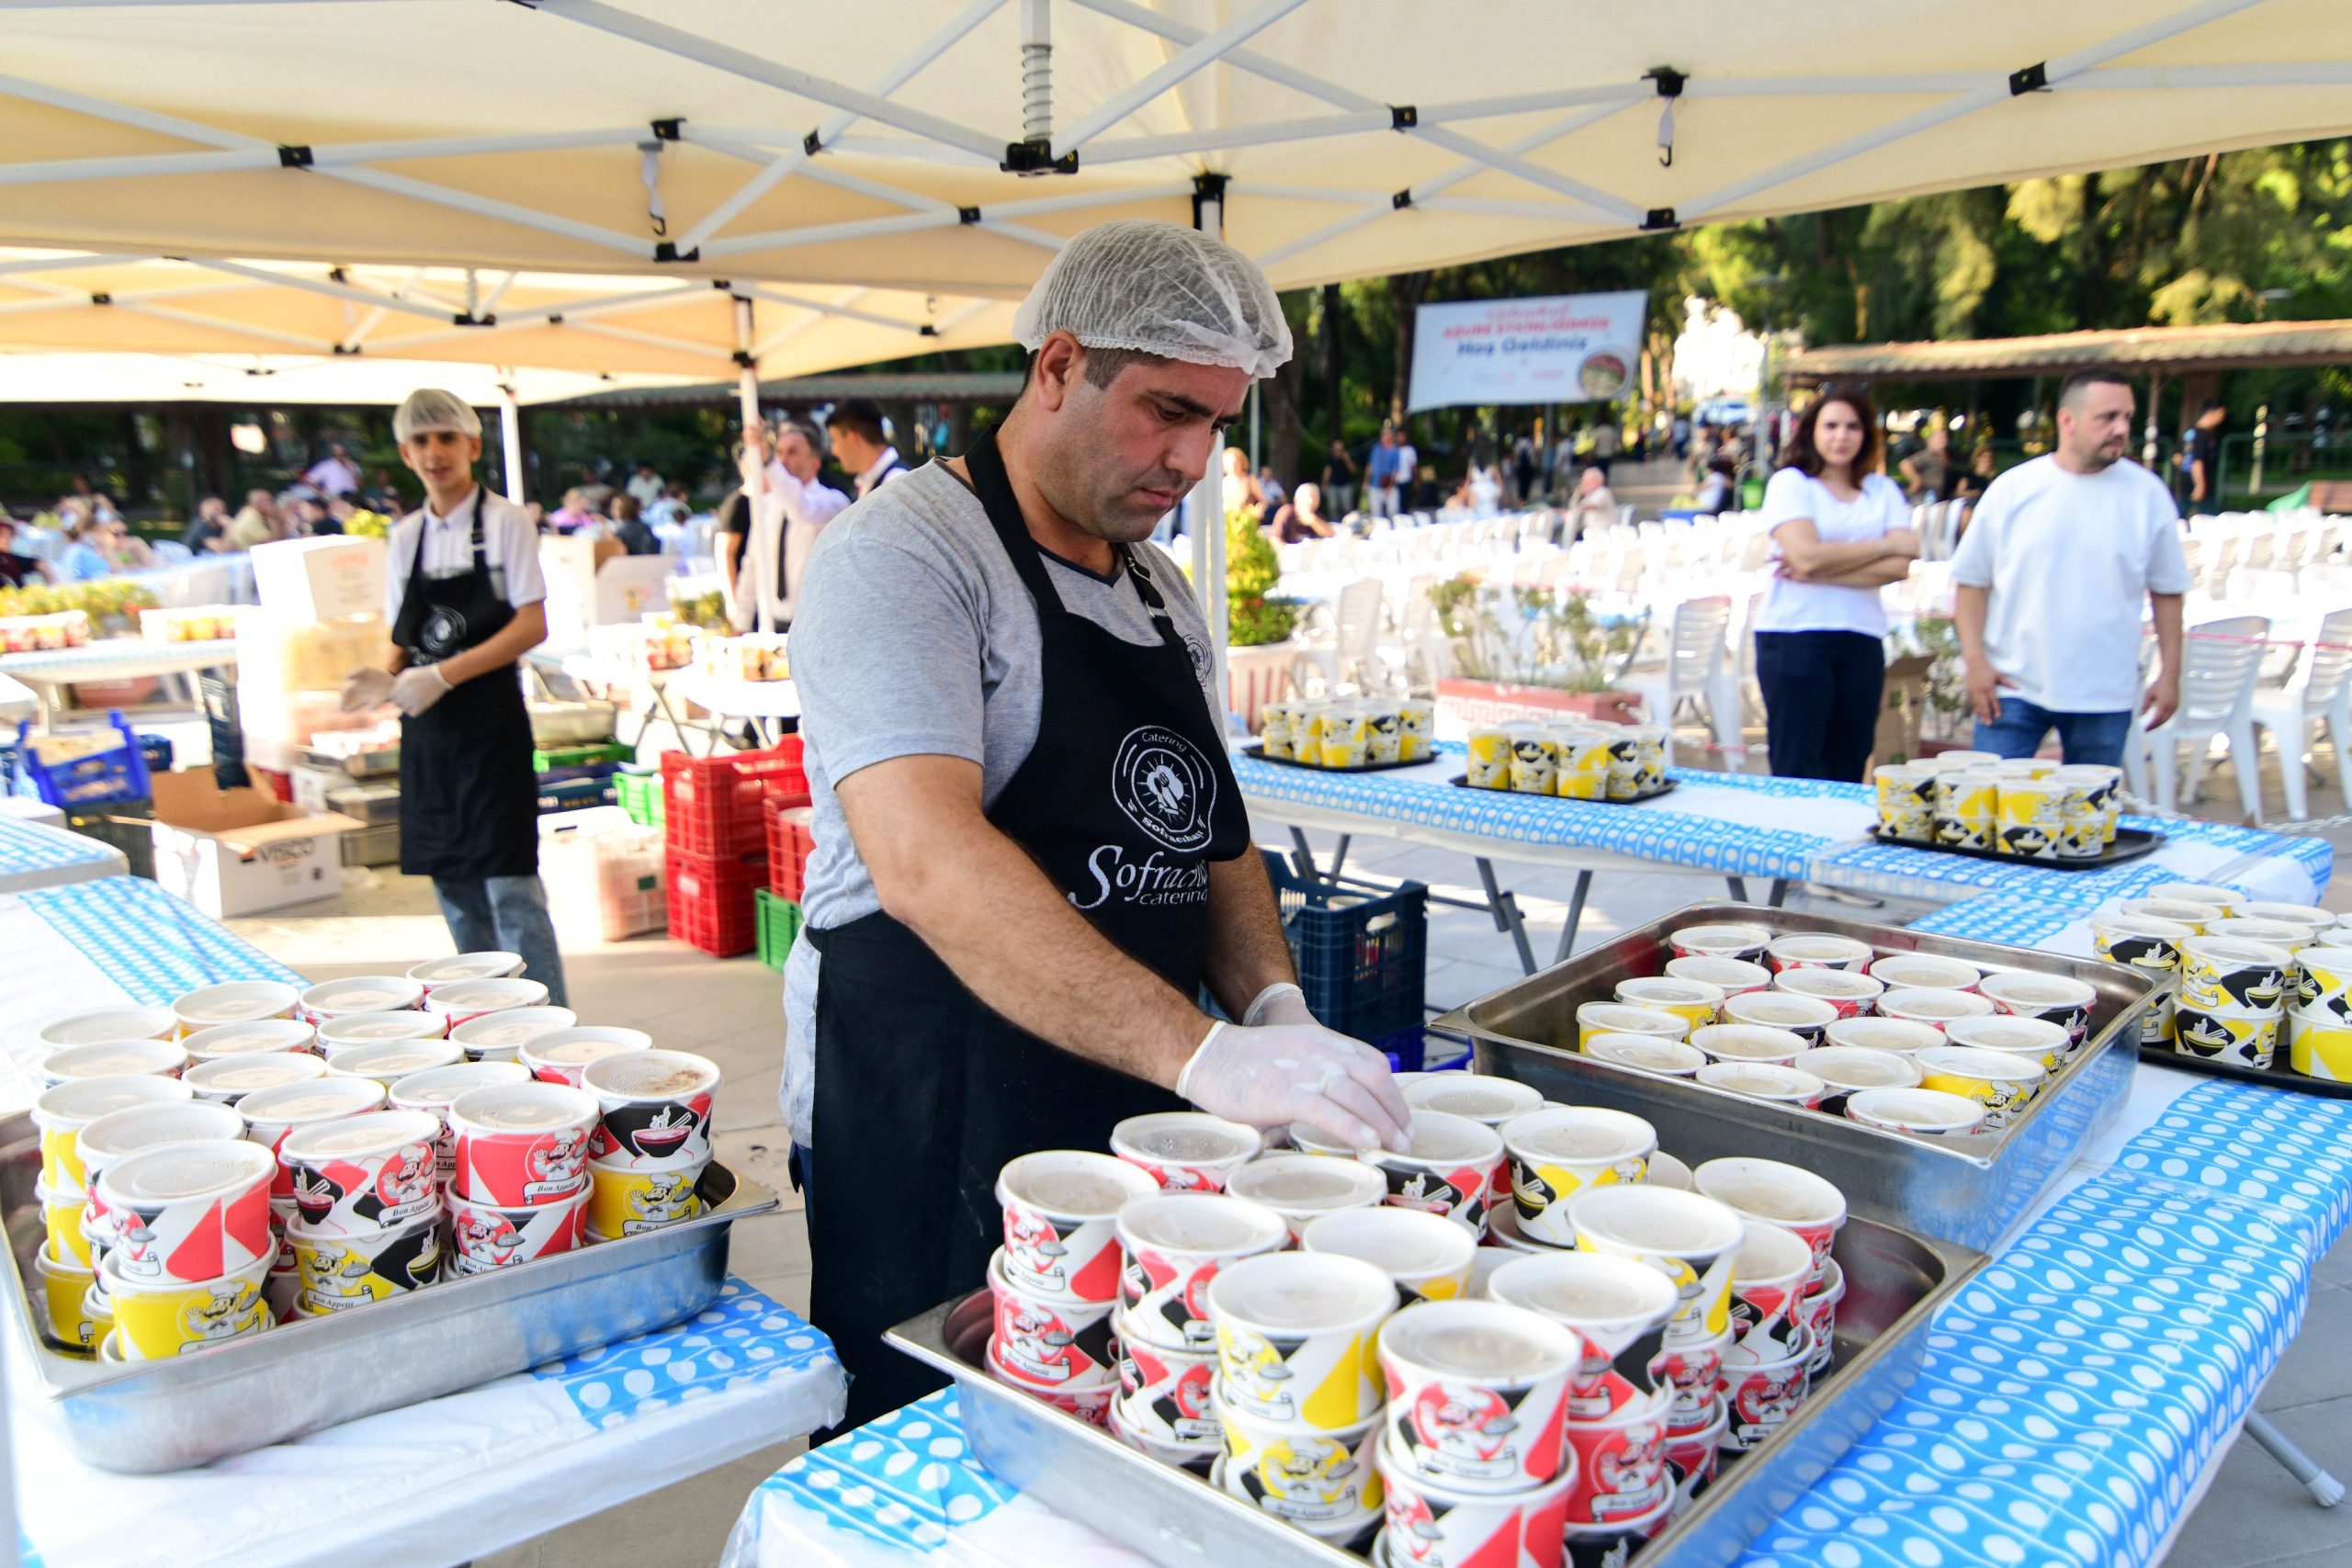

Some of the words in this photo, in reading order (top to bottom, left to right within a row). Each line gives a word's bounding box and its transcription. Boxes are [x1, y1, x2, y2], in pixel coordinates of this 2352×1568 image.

[1141, 732, 1188, 752] Catering
[1139, 887, 1208, 907] catering
[537, 1184, 552, 1192] Bon
[553, 1179, 576, 1192] Appetit
[392, 1206, 408, 1217] Bon
[410, 1200, 430, 1214] Appetit
[464, 1258, 477, 1269] Bon
[1021, 1271, 1045, 1287] Appetit
[312, 1295, 326, 1305] Bon
[327, 1297, 354, 1309] Appetit
[1008, 1350, 1021, 1363] Bon
[1023, 1362, 1049, 1376] Appetit
[1752, 1427, 1770, 1435] Bon
[1608, 1497, 1627, 1506] Bon
[1277, 1504, 1296, 1515] Bon
